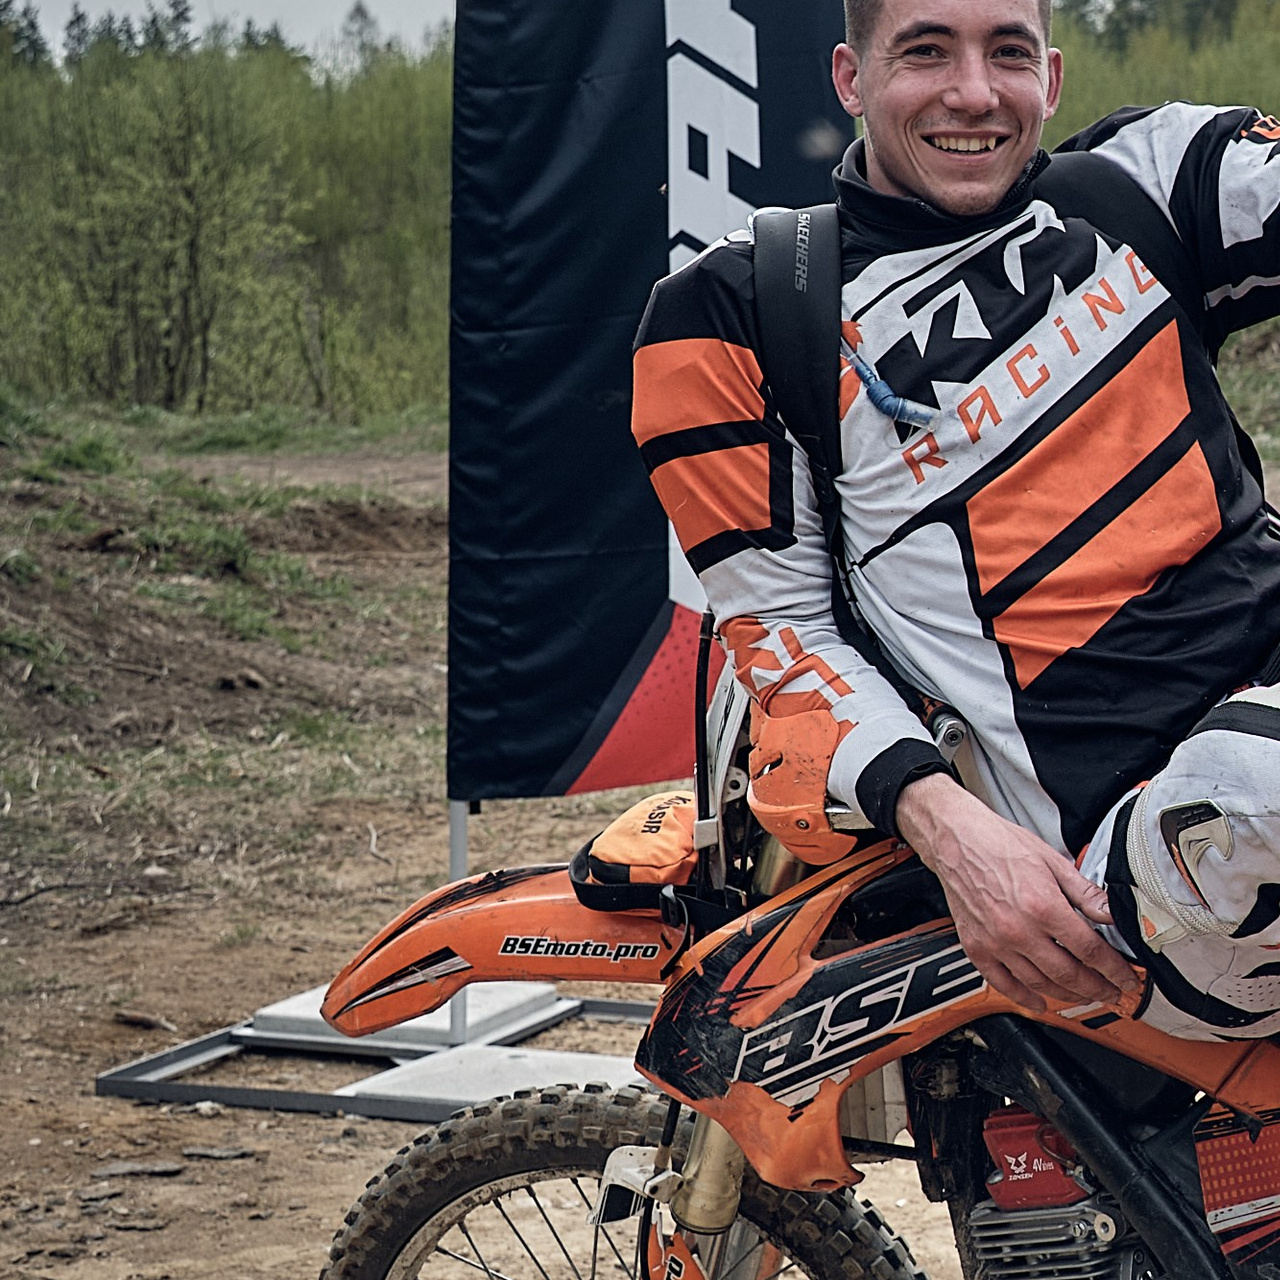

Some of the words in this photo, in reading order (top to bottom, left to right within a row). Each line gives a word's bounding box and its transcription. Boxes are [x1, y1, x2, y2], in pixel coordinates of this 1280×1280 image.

[795, 213, 810, 293] SKECHERS
[499, 936, 660, 962] BSEmoto.pro
[732, 944, 988, 1086] BSE
